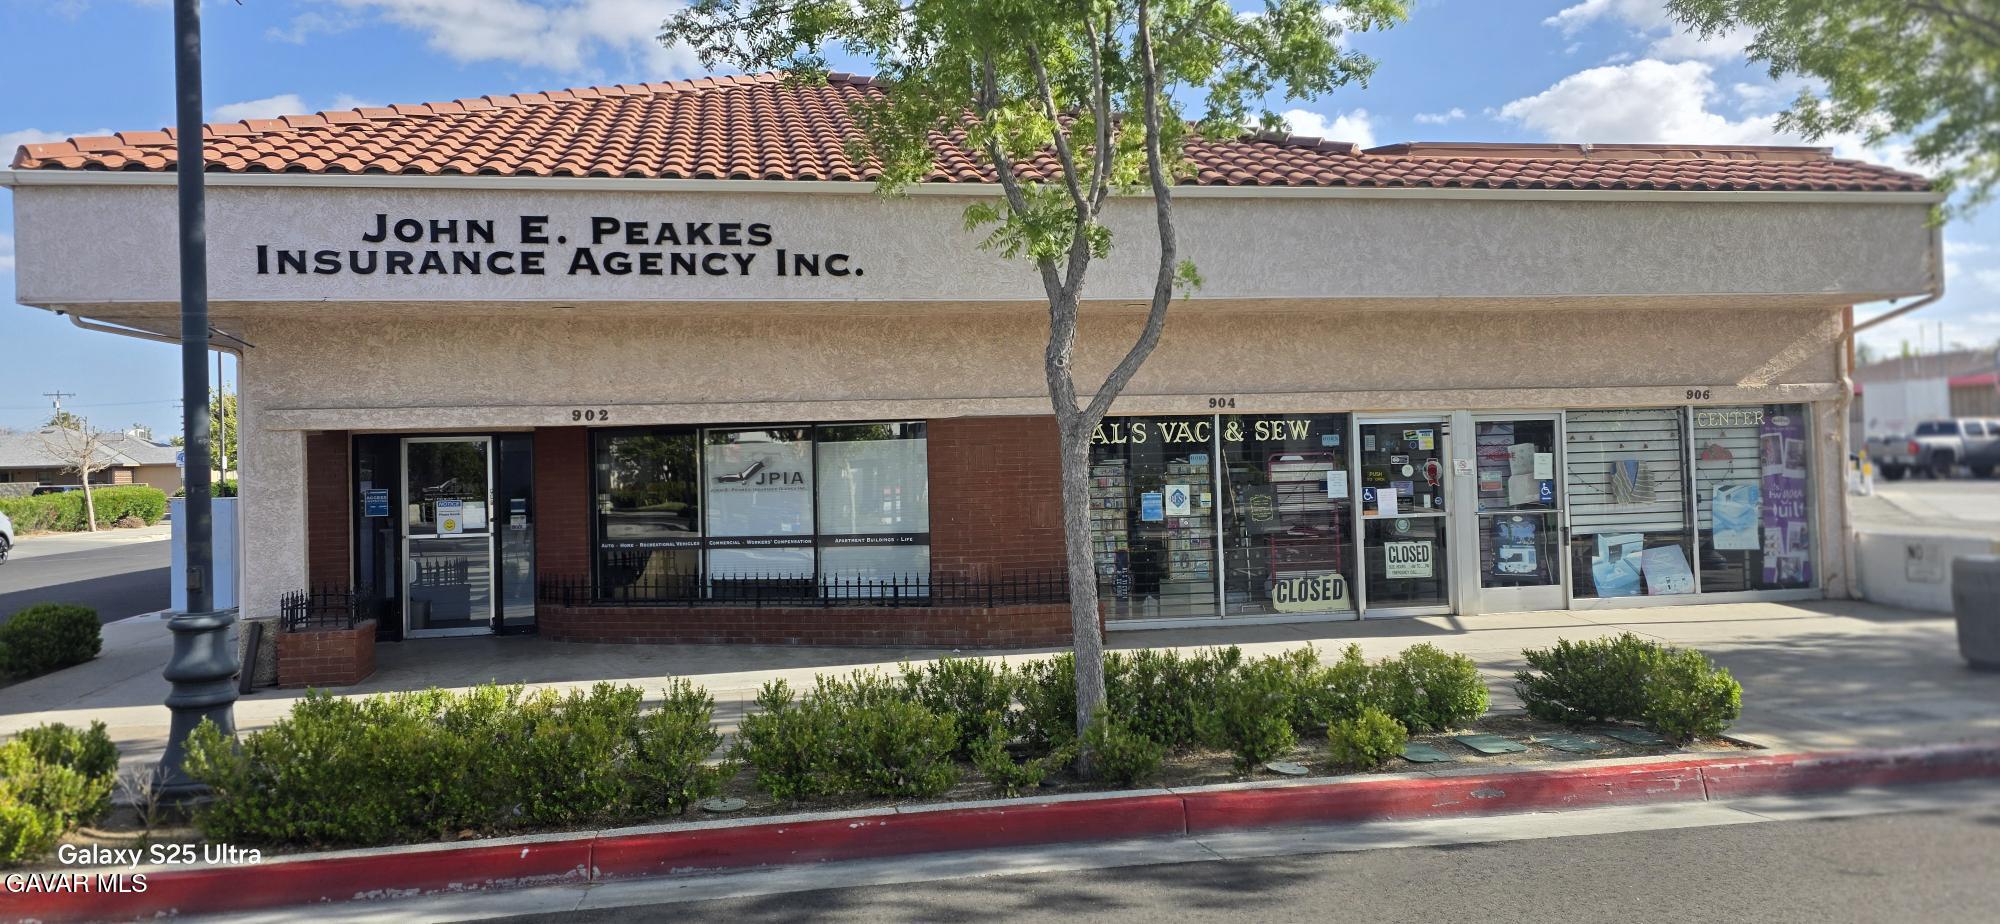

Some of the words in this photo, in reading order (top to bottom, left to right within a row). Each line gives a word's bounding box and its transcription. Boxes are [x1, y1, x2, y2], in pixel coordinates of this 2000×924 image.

[362, 214, 495, 244] JOHN
[521, 216, 567, 244] E.
[592, 217, 773, 246] PEAKES
[256, 245, 545, 275] INSURANCE
[568, 248, 757, 277] AGENCY
[777, 248, 864, 277] INC.
[1209, 398, 1236, 409] 904
[1686, 390, 1710, 400] 906
[572, 410, 609, 421] 902
[1697, 410, 1766, 428] CENTER
[1157, 421, 1211, 444] VAC
[1224, 421, 1245, 442] &
[1254, 420, 1311, 442] SEW
[756, 472, 804, 485] JPIA
[1388, 544, 1430, 563] CLOSED
[1275, 578, 1343, 604] CLOSED
